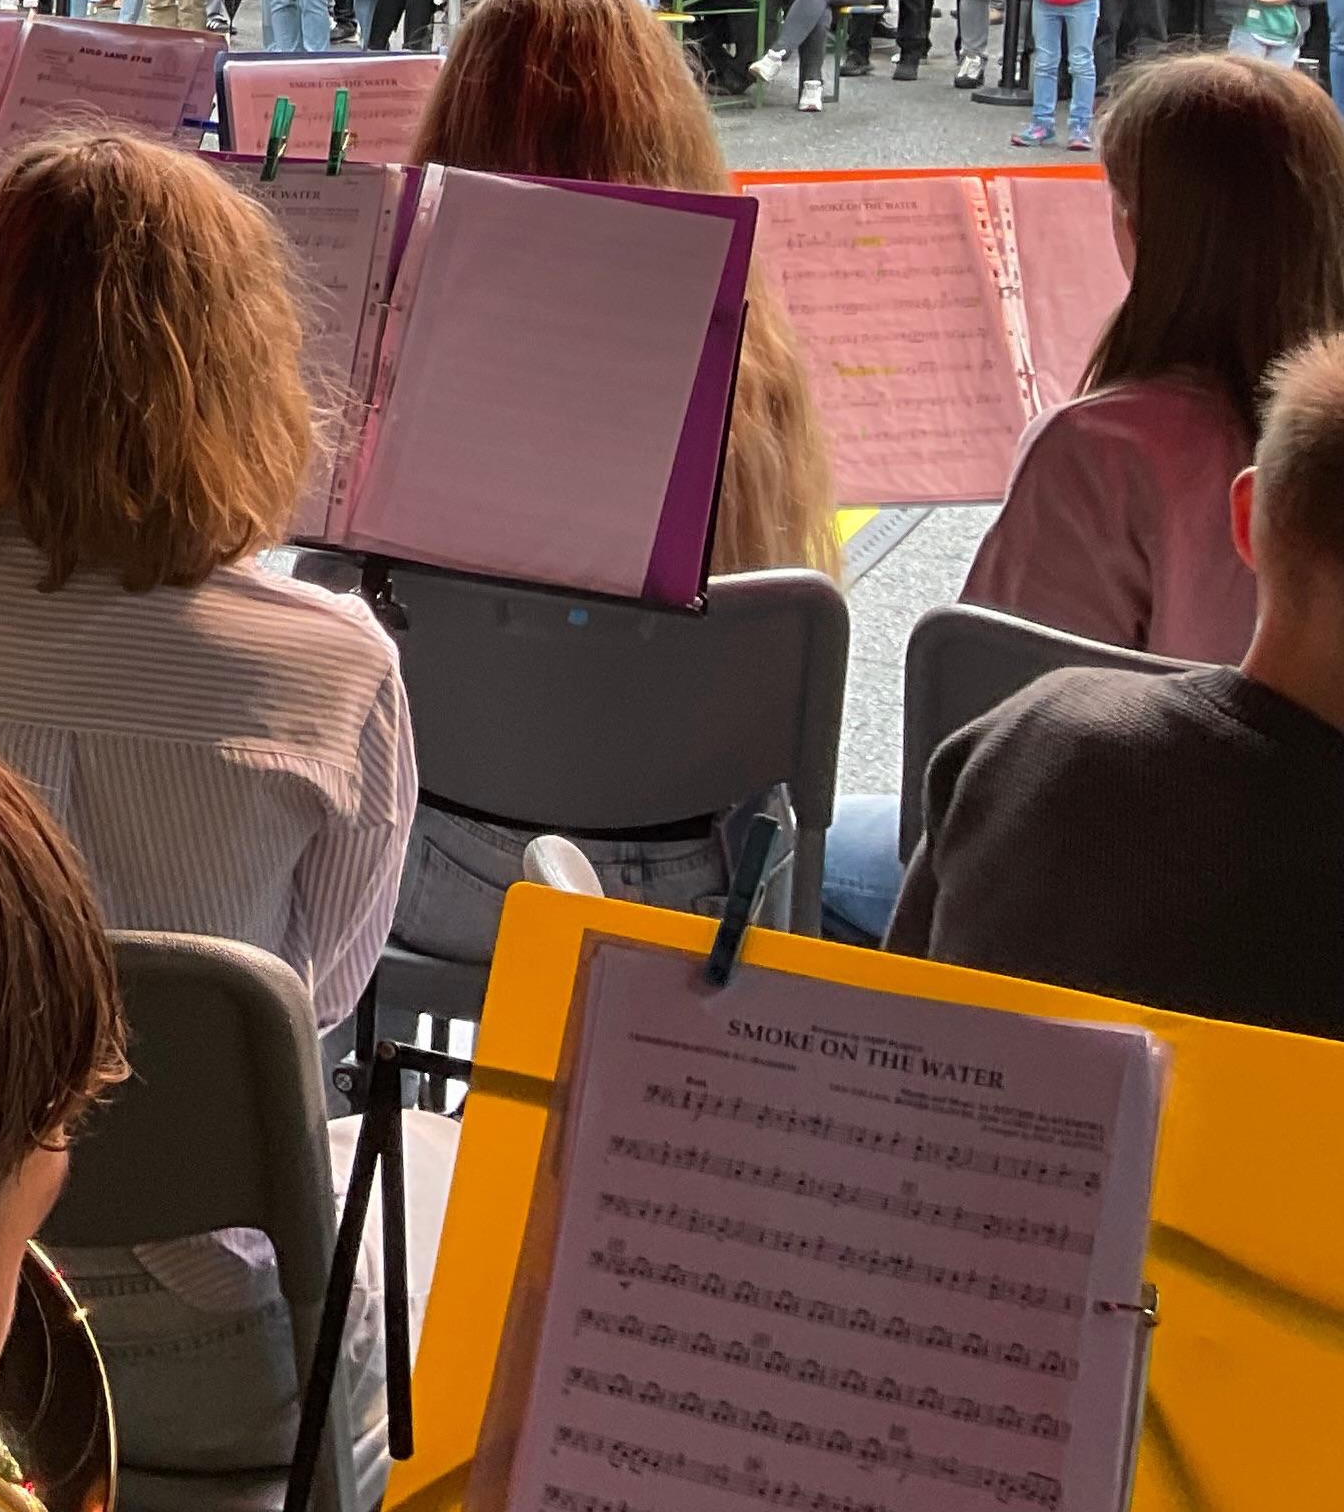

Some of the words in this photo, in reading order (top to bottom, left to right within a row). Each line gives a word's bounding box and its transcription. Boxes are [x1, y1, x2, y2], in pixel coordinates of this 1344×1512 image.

[364, 79, 398, 88] WATER
[281, 190, 321, 201] WATER
[727, 1018, 815, 1054] SMOKE
[820, 1036, 859, 1062] ON
[866, 1044, 916, 1074] THE
[921, 1055, 1006, 1091] WATER
